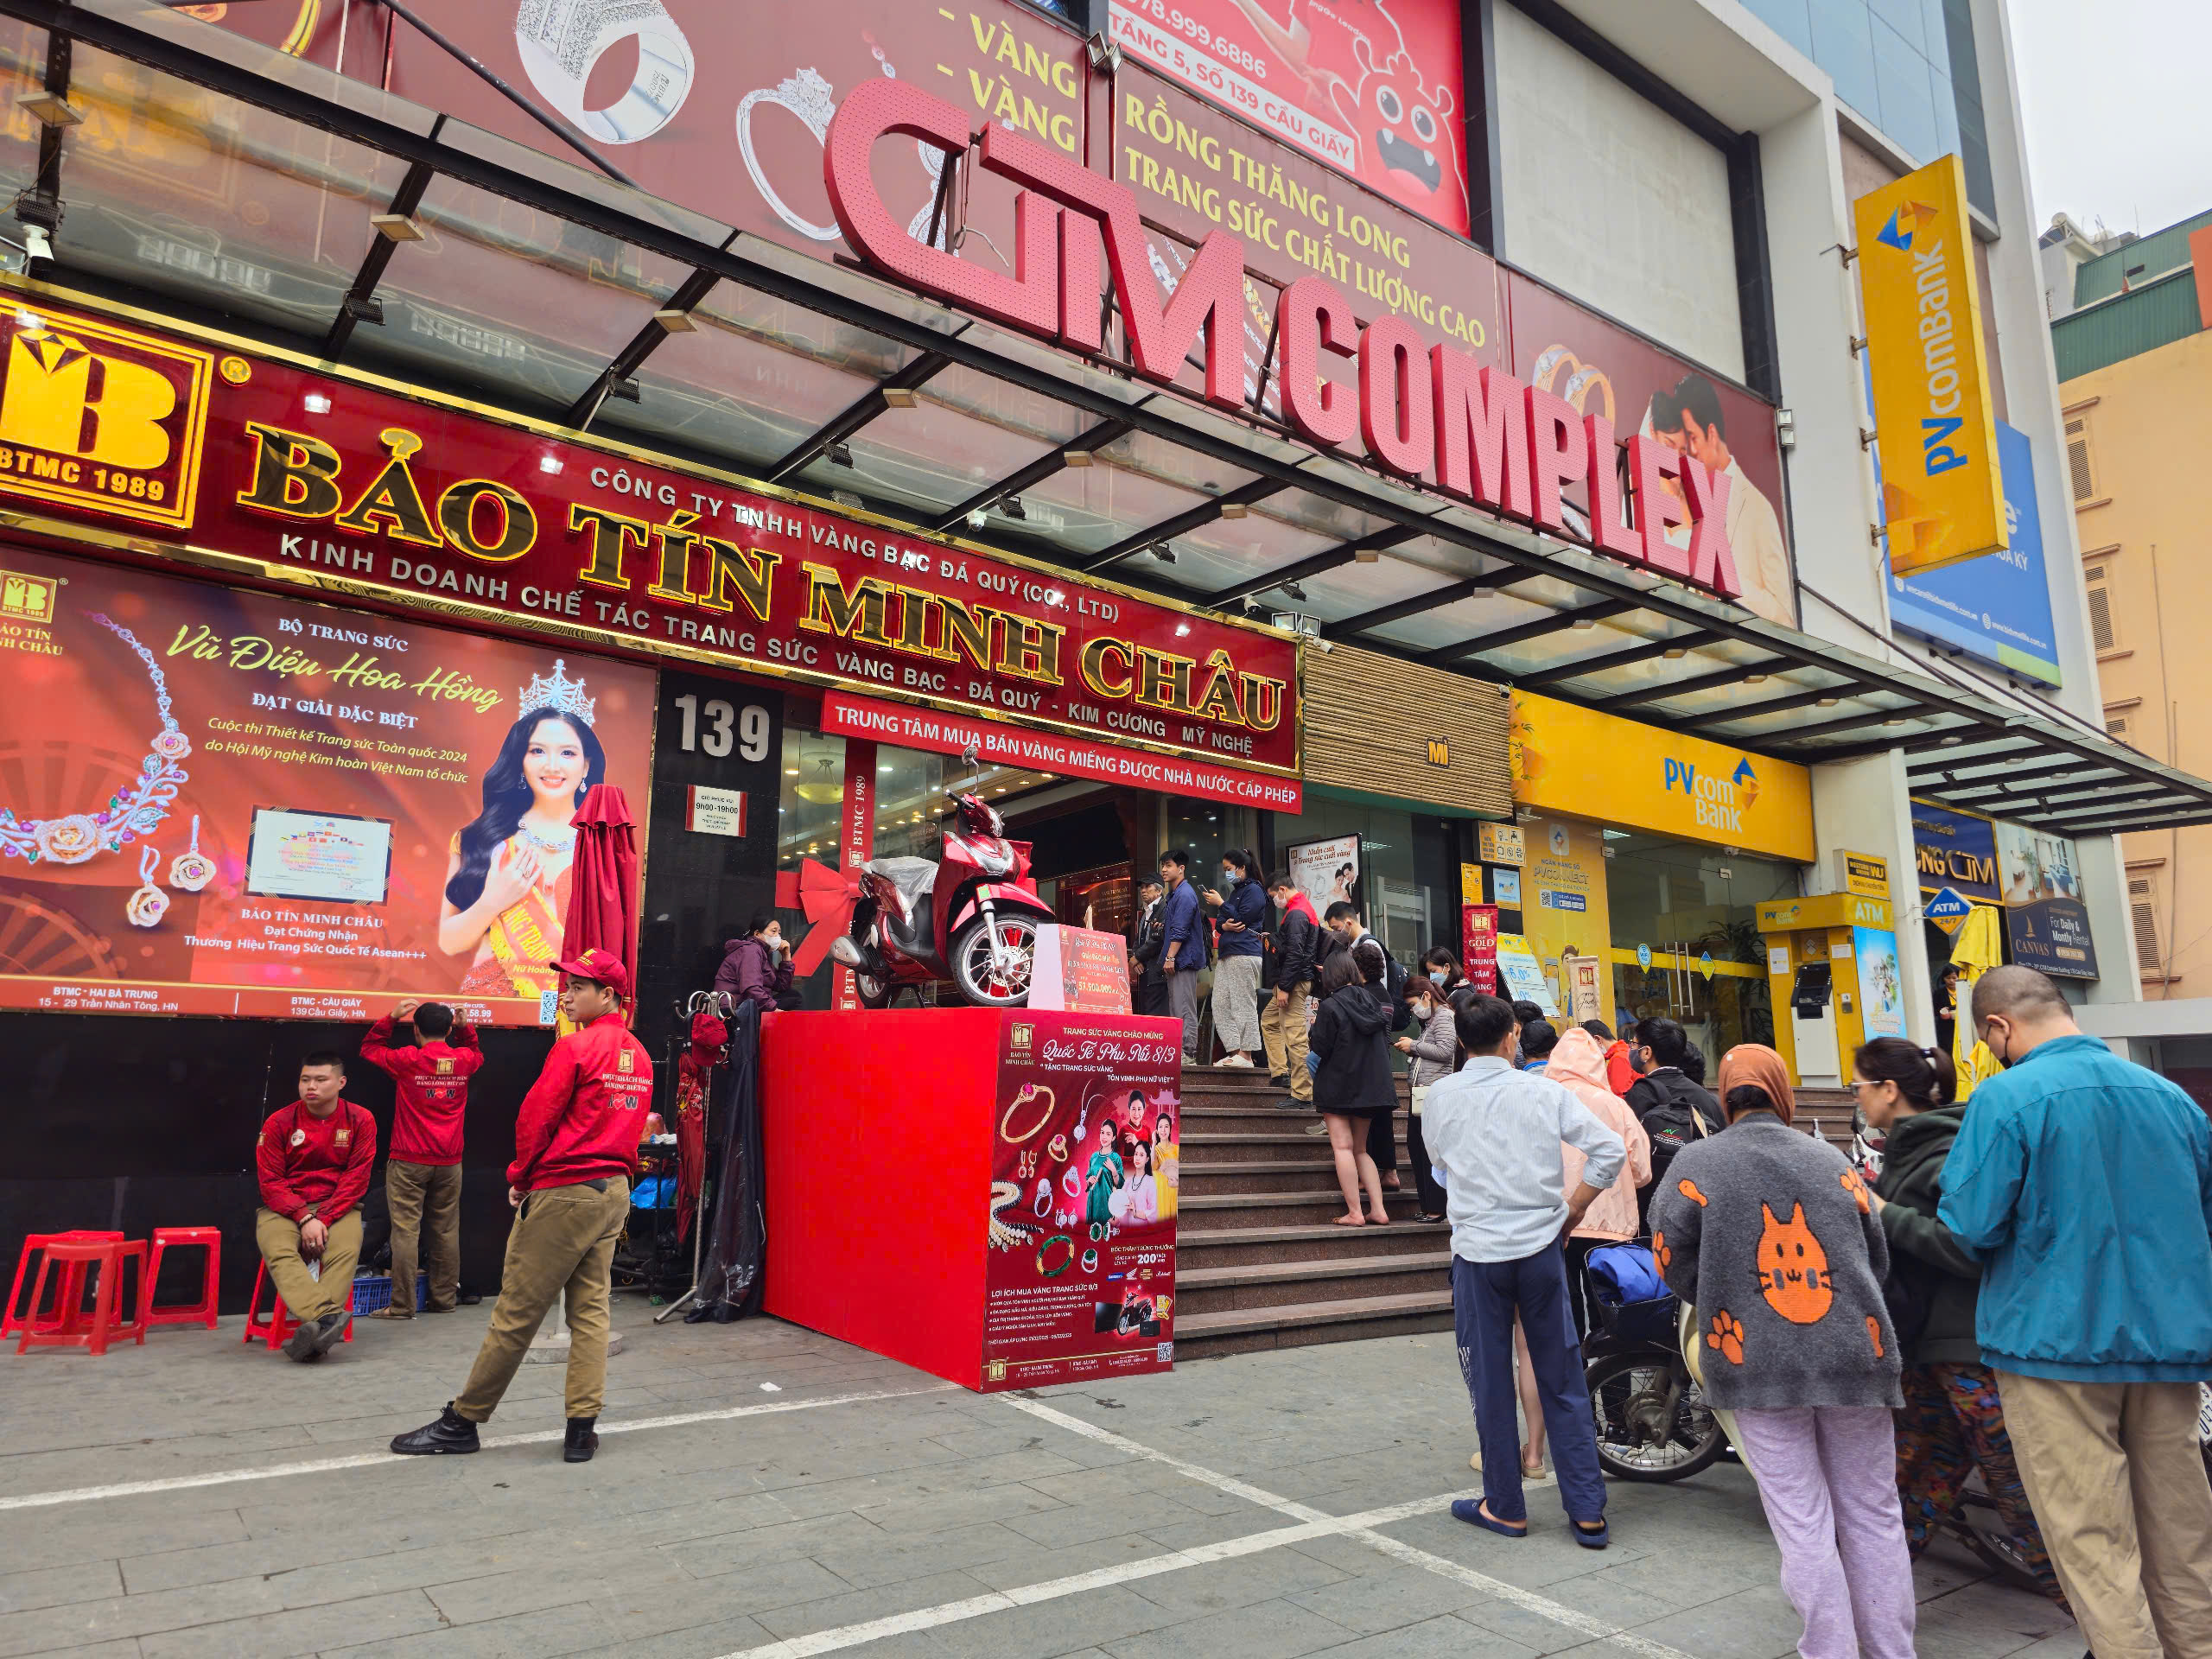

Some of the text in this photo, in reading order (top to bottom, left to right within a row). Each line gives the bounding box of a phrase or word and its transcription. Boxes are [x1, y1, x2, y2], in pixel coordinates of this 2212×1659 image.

[968, 8, 1076, 99] VÀNG
[1109, 10, 1351, 162] TẦNG SỐ 139 CẦU GIẤY
[970, 67, 1074, 152] VÀNG
[1125, 92, 1410, 269] RỒNG THĂNG LONG
[1125, 147, 1484, 349] TRANG SỨC CHẤT LƯỢNG CAO
[1912, 239, 1967, 478] PVcomBank
[1277, 276, 1742, 599] COMPLEX
[0, 447, 165, 502] BTMC 1989
[590, 467, 676, 507] CÔNG
[691, 493, 723, 517] TY
[732, 502, 802, 539] TNHH
[810, 524, 875, 559] VÀNG
[884, 544, 930, 574] BẠC
[940, 558, 969, 582] ĐÁ
[977, 569, 1020, 597] QUÝ
[1077, 596, 1119, 623] LTD)
[2015, 551, 2028, 571] KỲ
[236, 421, 1286, 732] BẢO TÍN MINH CHÂU
[19, 640, 63, 656] CHÂU
[25, 627, 52, 641] TÍN
[278, 619, 409, 652] BỘ TRANG SỨC
[280, 533, 1253, 755] KINH DOANH CHẾ TÁC TRANG SỨC VÀNG BẠC ĐÁ QUÝ KIM CƯƠNG MỸ NGHỆ
[166, 624, 504, 714] Vũ Điệu Hoa Hồng
[252, 692, 418, 729] ĐẠT GIẢI ĐẶC BIỆT
[208, 717, 468, 763] Cuộc thi Thiết kế Trang sức Toàn quốc 2024
[675, 694, 770, 762] 139
[206, 740, 468, 783] do Hội Mỹ nghệ Kim hoàn Việt Nam chức
[836, 706, 1296, 805] TRUNG TÂM MUA BÁN VÀNG MIẾNG ĐƯỢC NHÀ NƯỚC CẤP PHÉP
[1427, 736, 1450, 769] MÌ
[855, 775, 865, 803] 1989
[1663, 758, 1734, 805] PVcom
[853, 808, 864, 846] BTMC
[1695, 798, 1742, 833] Bank
[241, 907, 383, 928] BẢO TÍN MINH CHÂU
[1855, 901, 1885, 925] ATM
[1932, 902, 1960, 913] ATM
[264, 926, 358, 941] Đạt Chứng Nhận
[2050, 916, 2059, 928] For
[2060, 918, 2075, 933] Daily
[184, 936, 427, 959] Thương Hiệu Trang Sức Quốc Asean+++
[1469, 938, 1494, 947] GOLD
[2015, 938, 2050, 957] CANVAS
[2072, 934, 2090, 946] Rental
[527, 964, 556, 976] Hoàng
[39, 998, 178, 1011] 15 29 Nhân HN
[54, 987, 158, 1000] BTMC HAI TRƯNG
[291, 996, 315, 1006] BTMC
[290, 1007, 307, 1015] 139
[1063, 1027, 1086, 1035] TRANG
[1043, 1039, 1175, 1065] Quốc Phụ 8/3
[1137, 1254, 1156, 1264] 200
[1033, 1286, 1052, 1294] VÀNG
